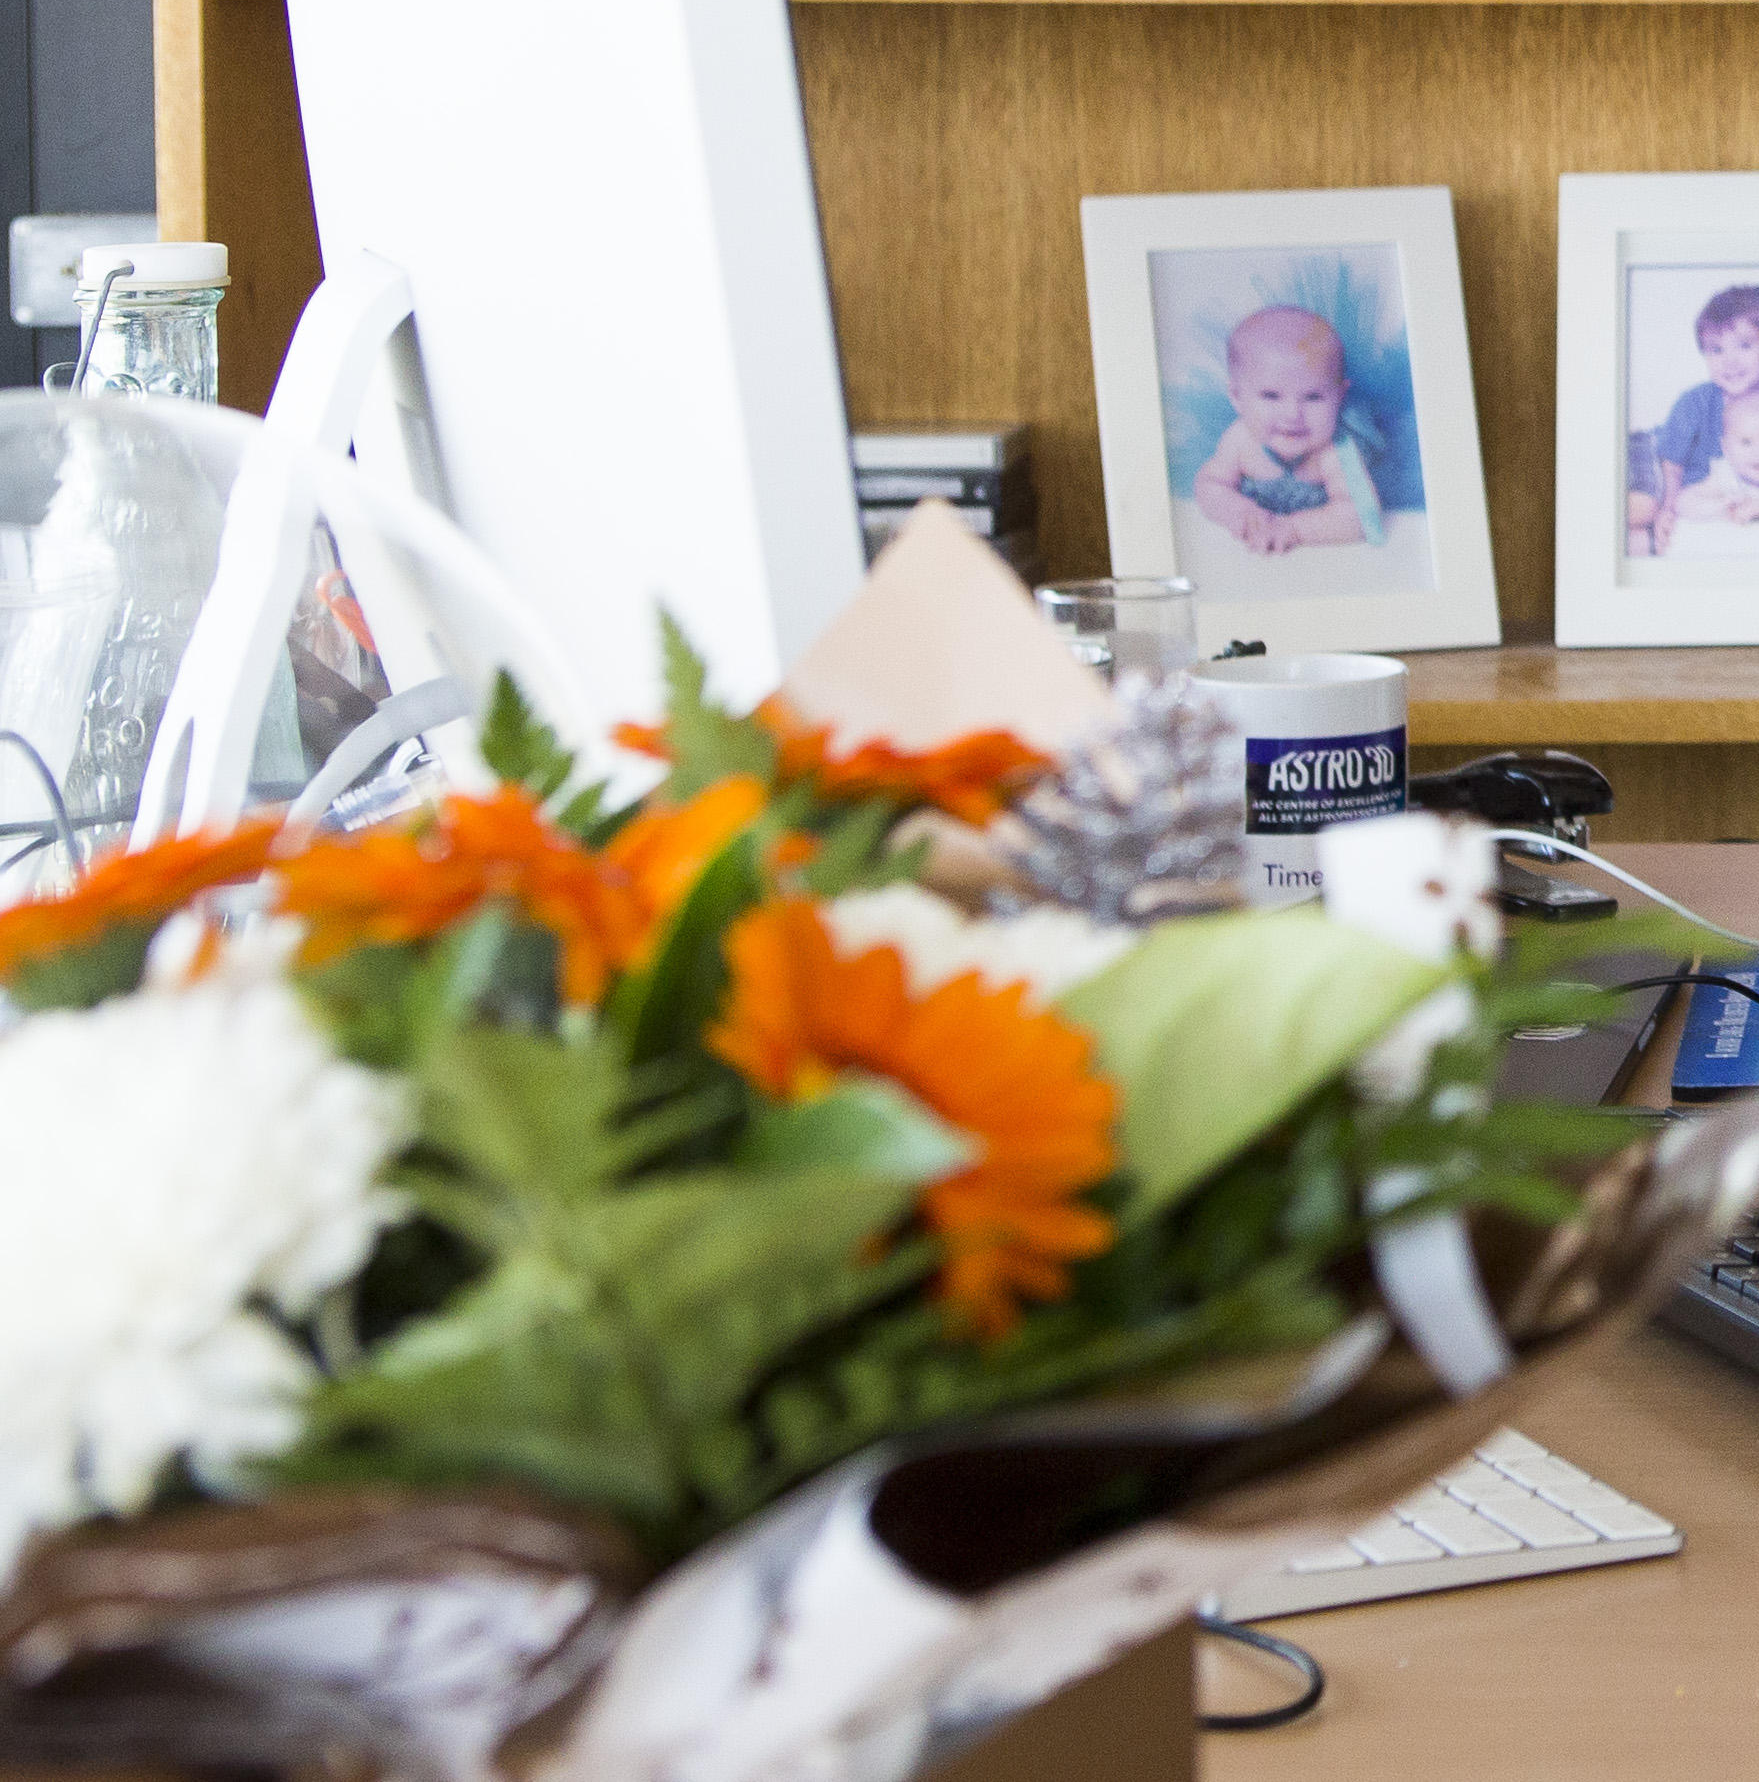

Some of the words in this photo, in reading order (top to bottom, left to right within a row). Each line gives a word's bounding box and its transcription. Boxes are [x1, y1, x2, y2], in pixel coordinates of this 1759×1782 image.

[1268, 748, 1363, 792] ASTRO
[1364, 744, 1396, 786] 3D
[1252, 799, 1274, 810] ARC
[1276, 799, 1319, 810] CENTRE
[1320, 798, 1335, 810] OF
[1336, 791, 1391, 809] EXCELLENCE
[1258, 812, 1278, 824] ALL
[1279, 812, 1301, 824] SKY
[1262, 862, 1324, 889] Time
